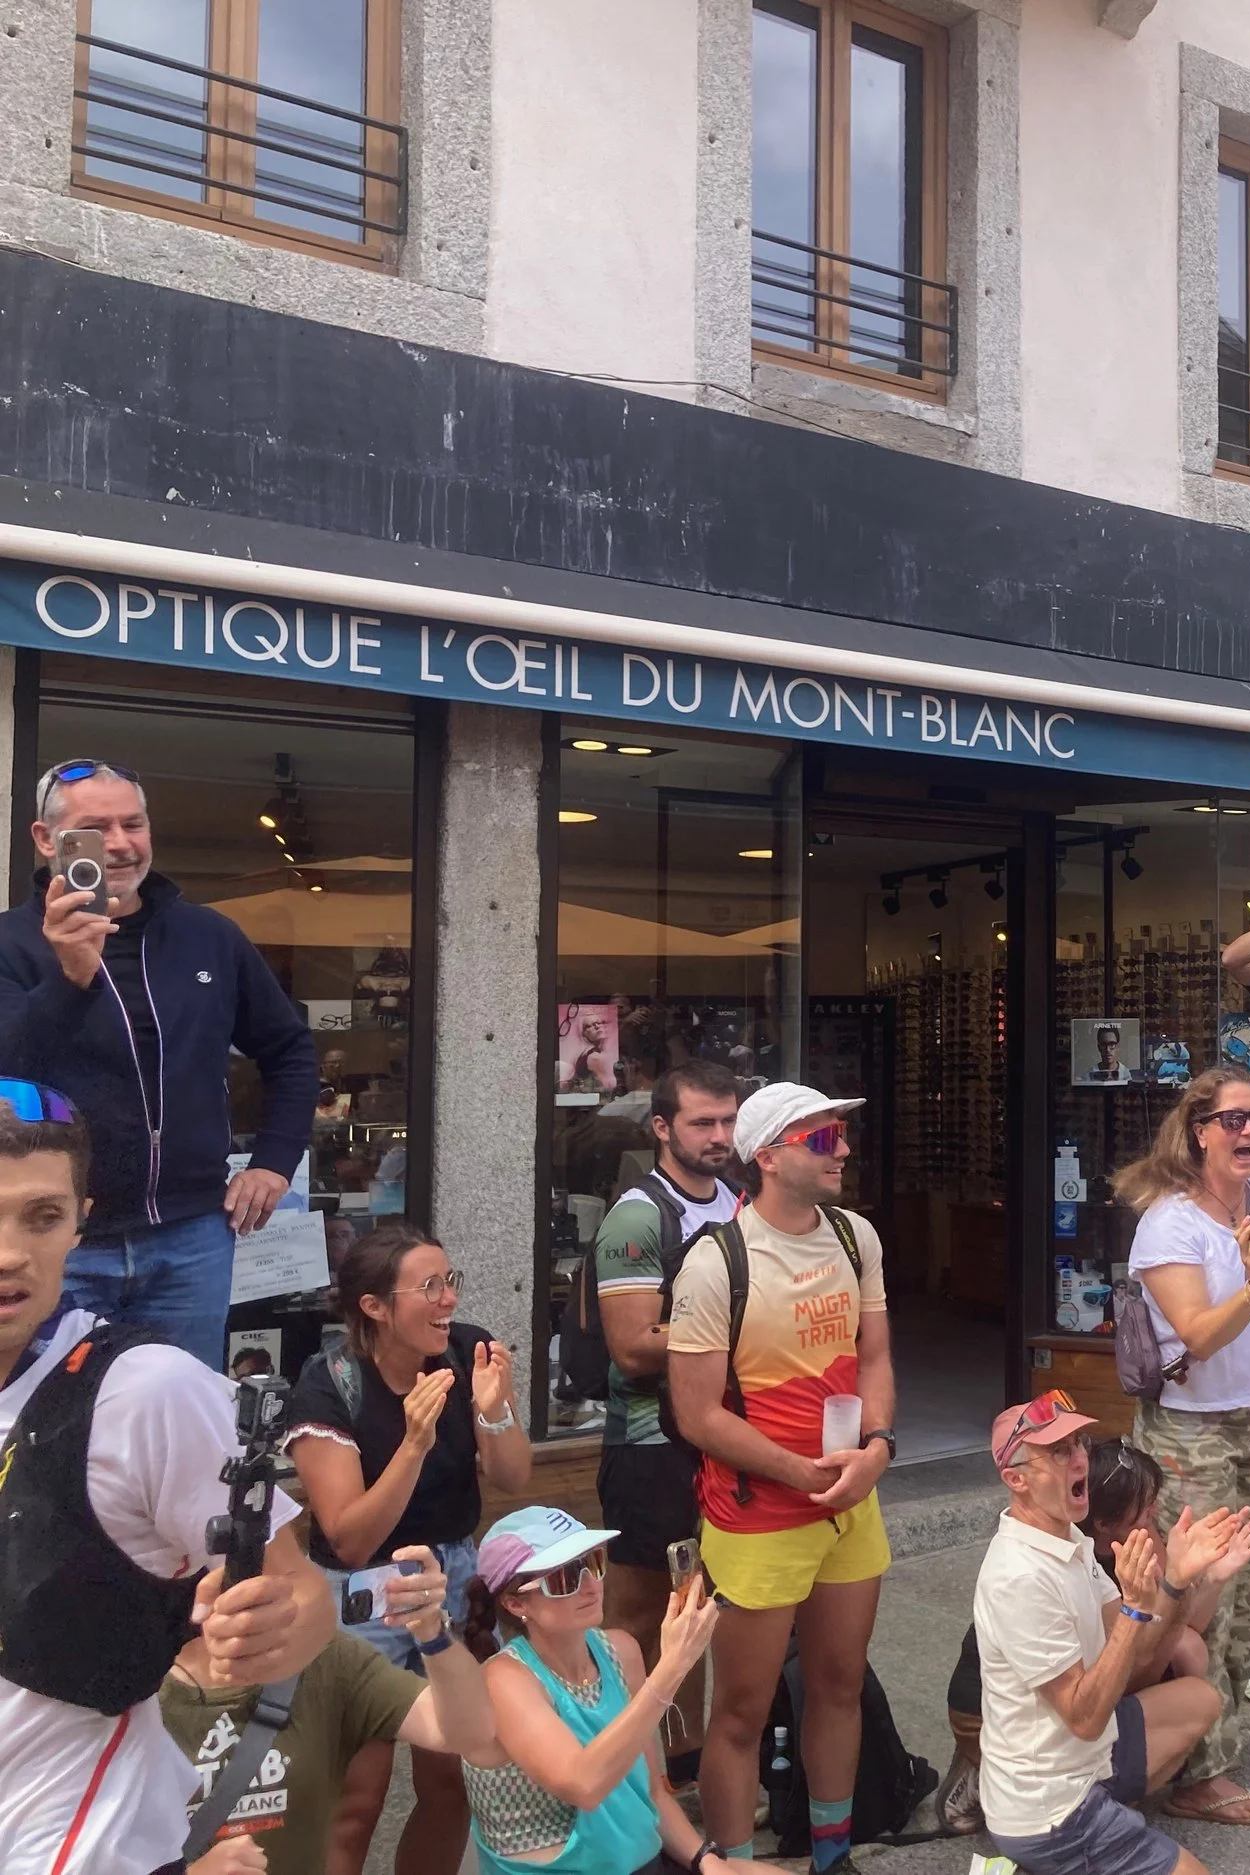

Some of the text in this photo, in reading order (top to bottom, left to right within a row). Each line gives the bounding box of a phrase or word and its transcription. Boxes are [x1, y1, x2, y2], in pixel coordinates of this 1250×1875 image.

[36, 574, 382, 676] OPTIQUE
[623, 654, 701, 713] DU
[729, 667, 1075, 760] MONT-BLANC
[814, 1003, 885, 1014] AKLEY
[795, 1292, 851, 1324] MÜGA
[797, 1316, 853, 1349] TRAIL
